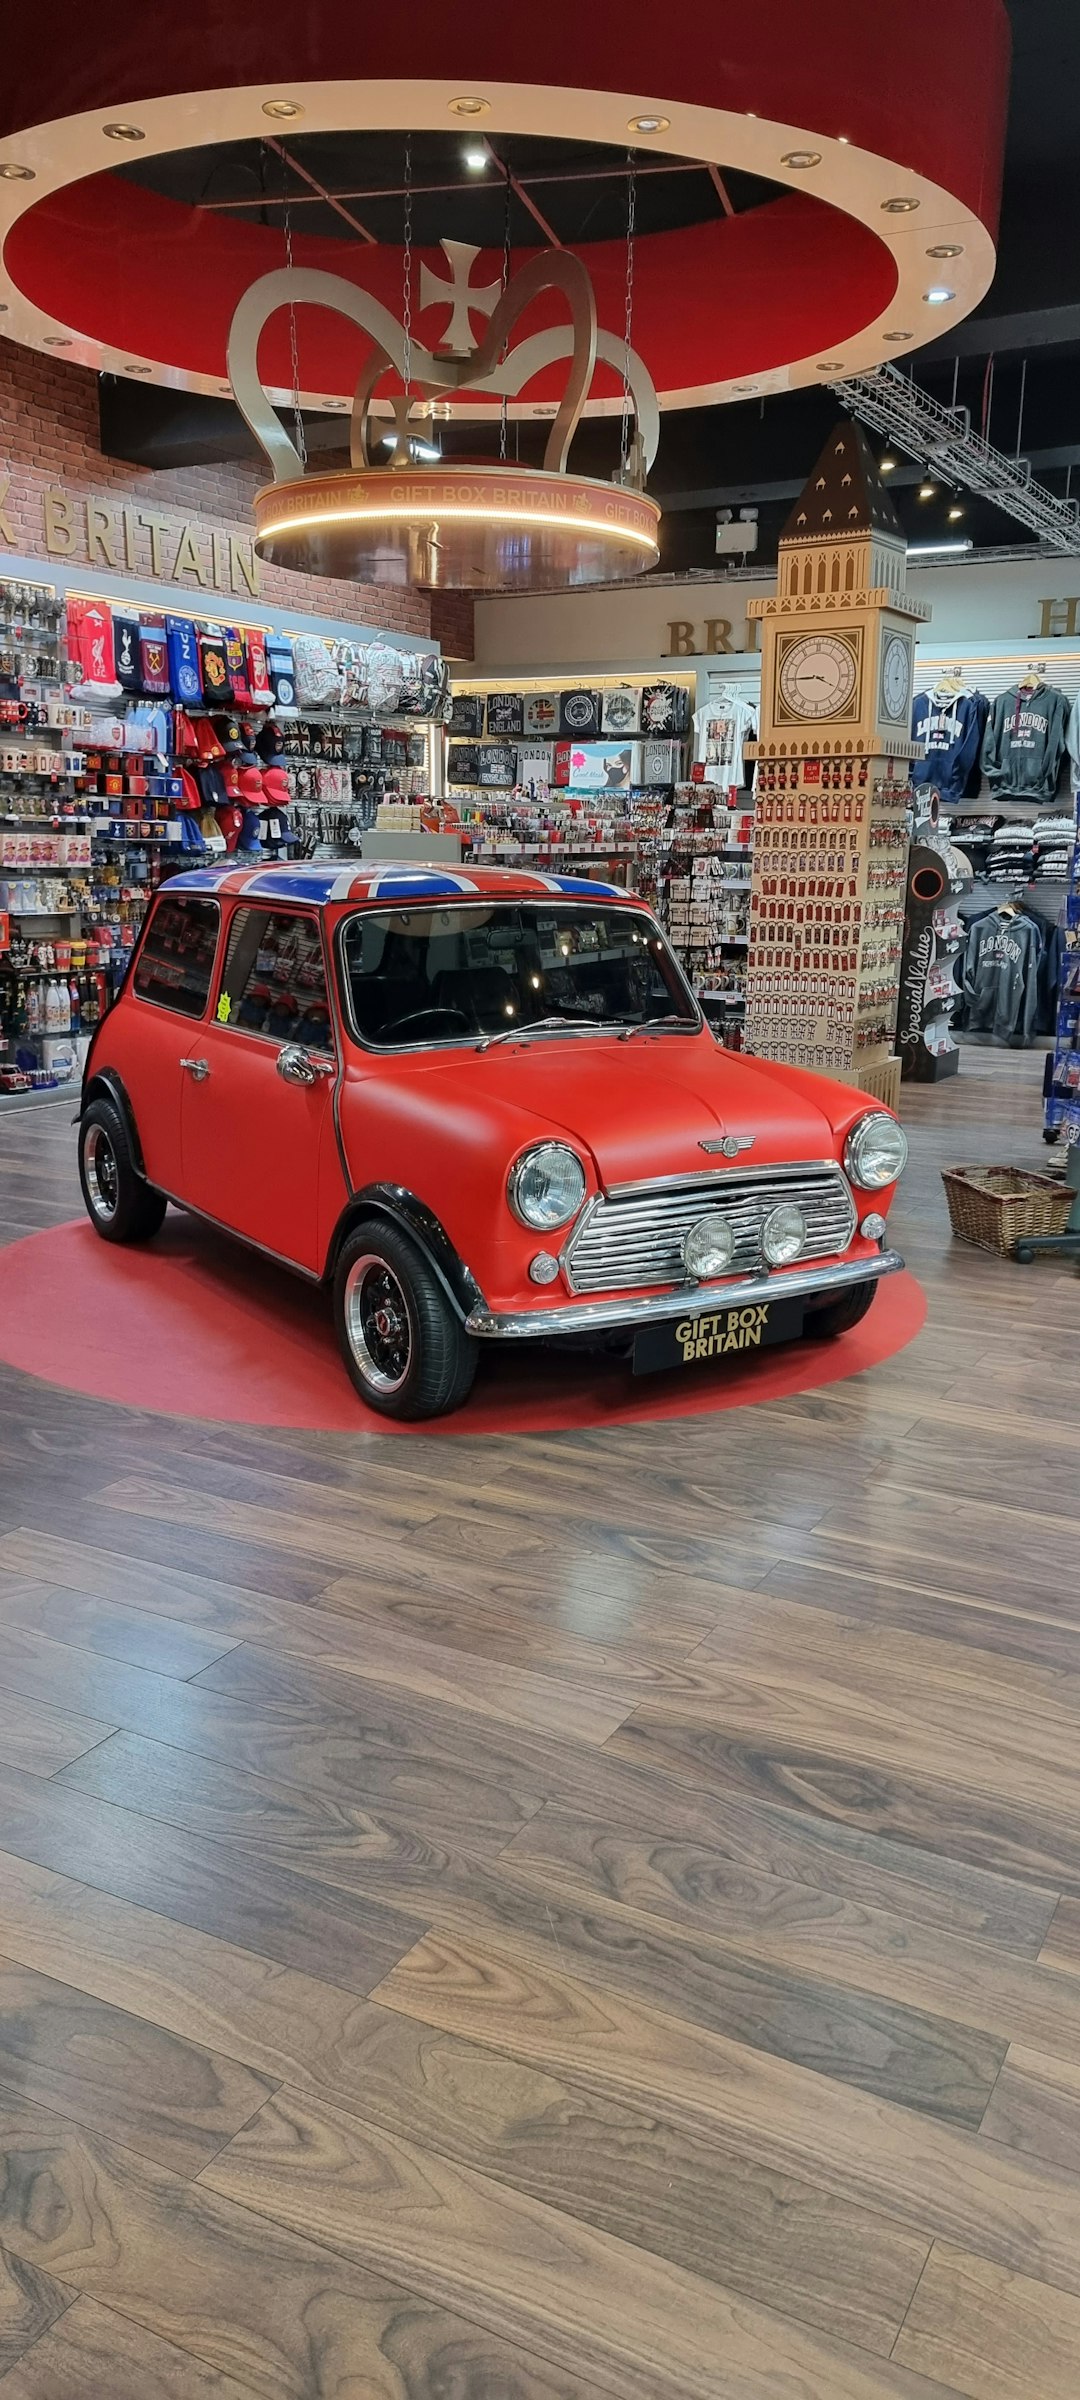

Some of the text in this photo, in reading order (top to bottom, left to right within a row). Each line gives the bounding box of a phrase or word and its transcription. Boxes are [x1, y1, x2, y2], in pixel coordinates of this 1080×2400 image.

[287, 491, 341, 515] BRITAIN
[390, 485, 568, 510] GIFT BOX BRITAIN
[604, 502, 632, 522] GIFT
[44, 486, 261, 598] BRITAIN
[667, 617, 762, 656] BRI
[93, 667, 107, 678] LFC
[487, 694, 520, 712] LONDON
[488, 720, 521, 733] ENGLAND
[480, 748, 517, 768] LONDON
[518, 749, 552, 763] LONDON
[645, 743, 671, 758] LONDON
[979, 934, 1022, 964] LONDON
[900, 926, 936, 1044] Special Value
[675, 1304, 769, 1343] GIFT BOX
[682, 1325, 762, 1362] BRITAIN
